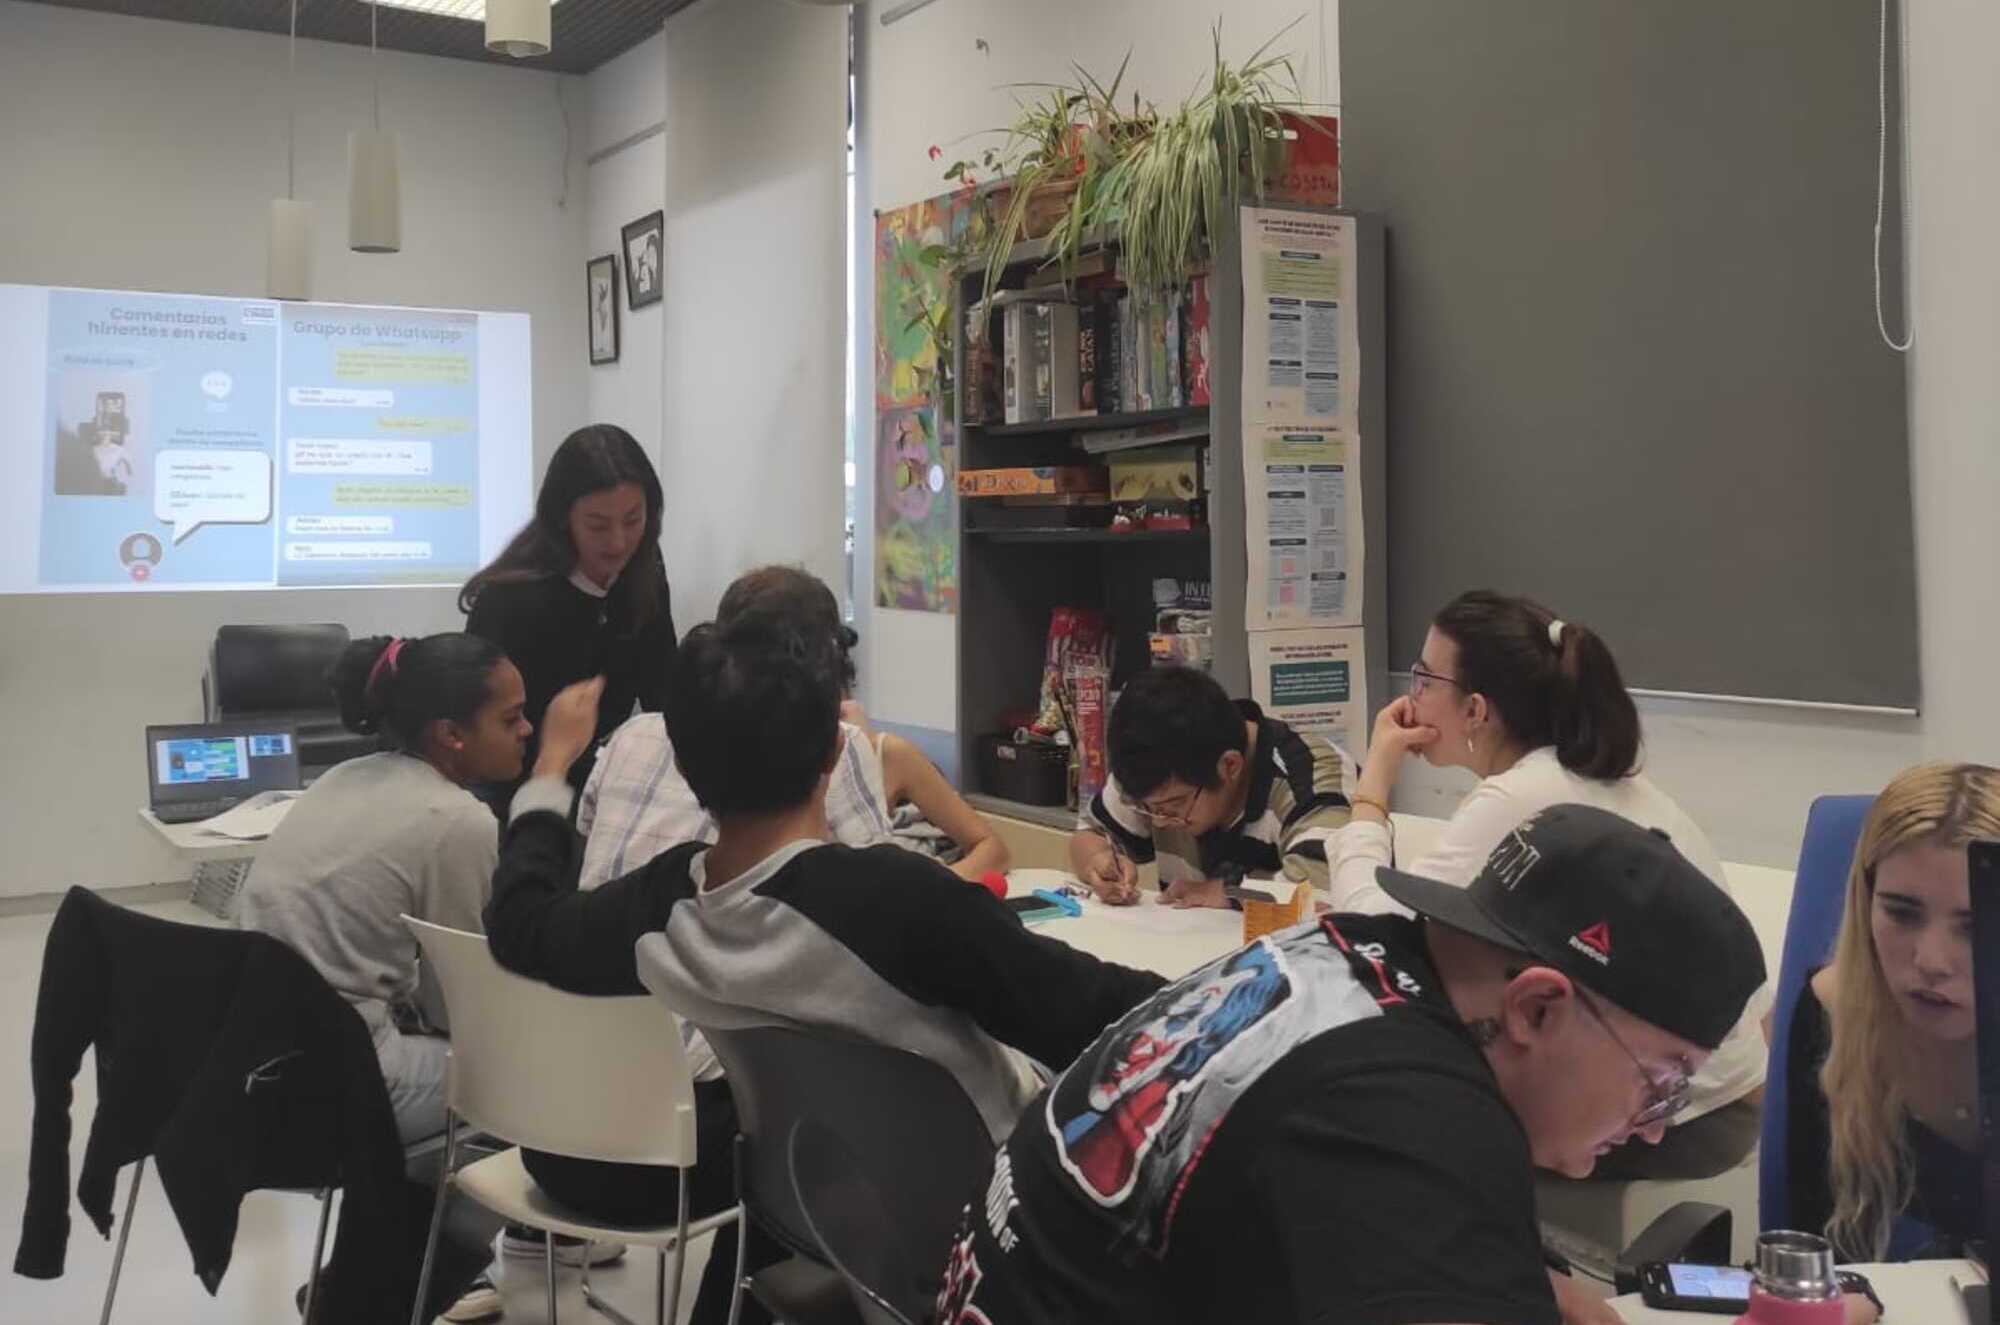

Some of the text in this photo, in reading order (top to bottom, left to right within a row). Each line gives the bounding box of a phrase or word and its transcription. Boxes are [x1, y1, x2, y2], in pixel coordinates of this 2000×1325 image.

[109, 306, 228, 325] Comentarios
[198, 327, 248, 342] redes
[293, 320, 347, 341] Grupo
